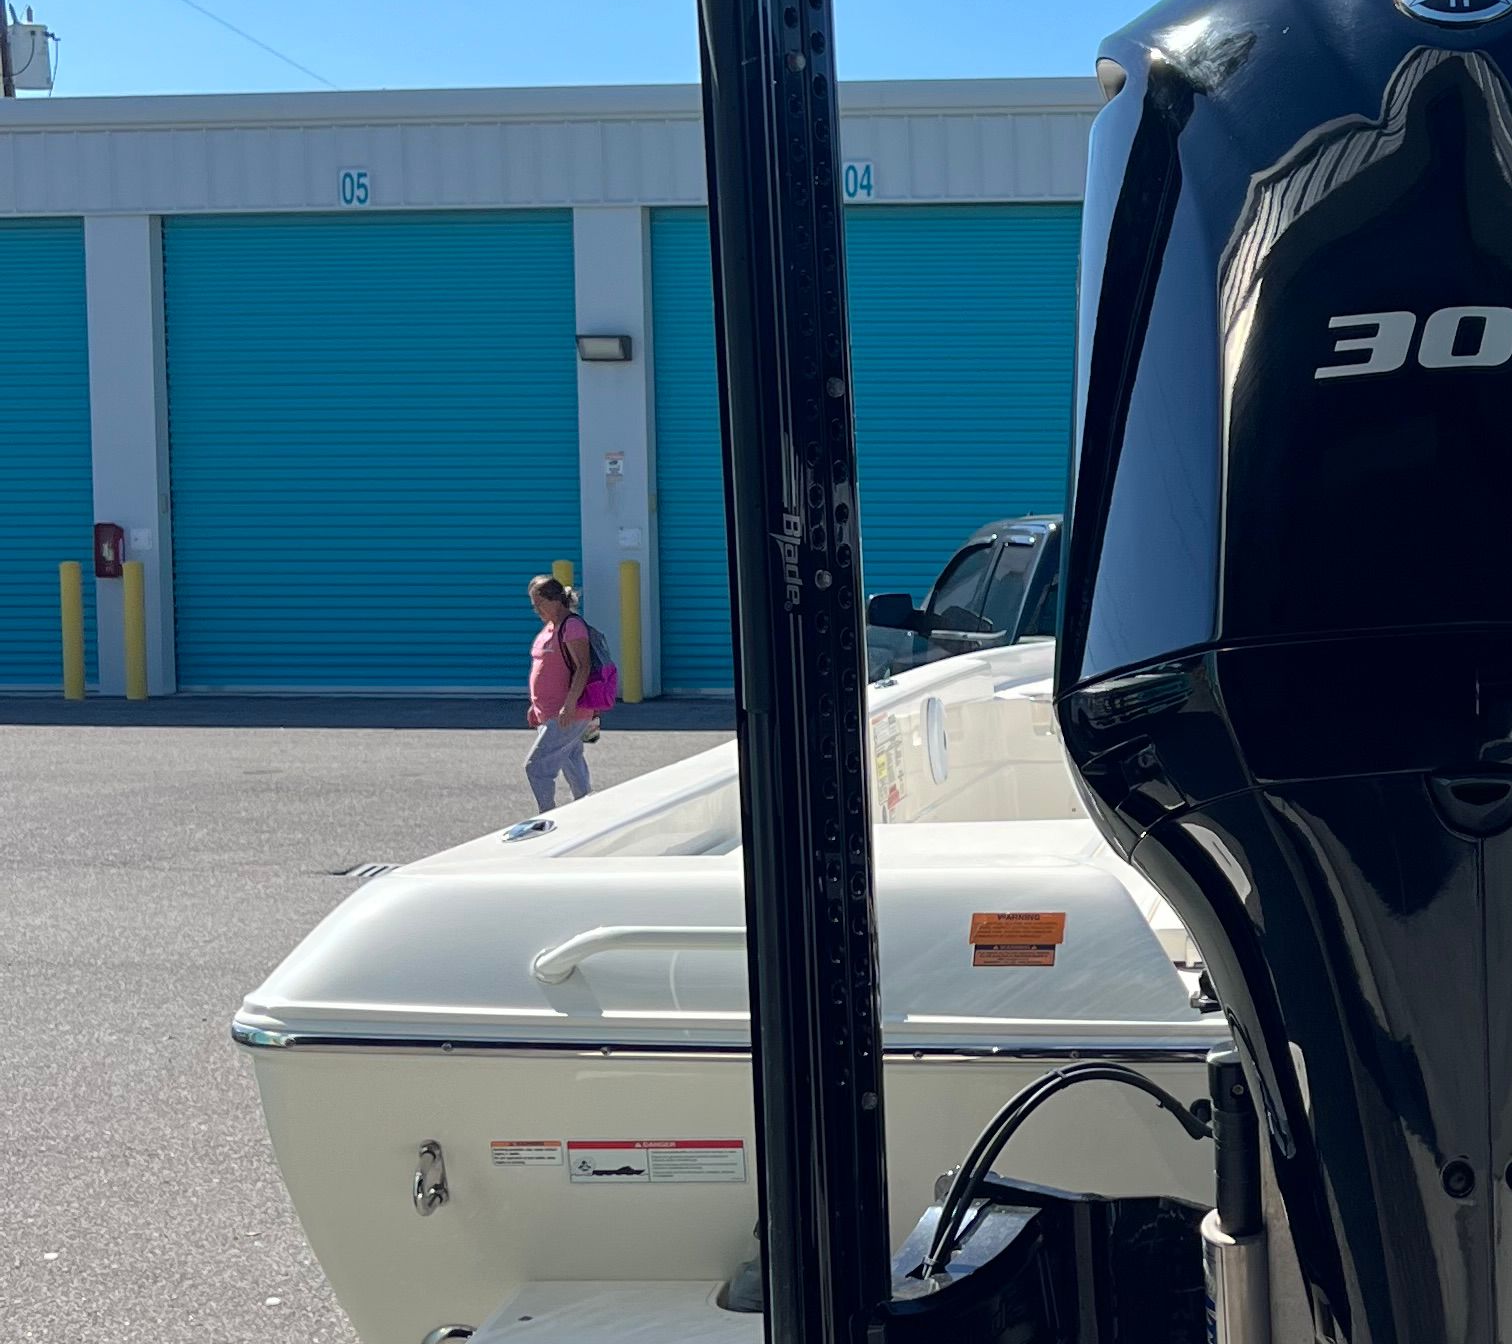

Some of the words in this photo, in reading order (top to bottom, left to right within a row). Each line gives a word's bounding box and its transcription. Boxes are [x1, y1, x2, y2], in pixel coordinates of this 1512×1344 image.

[342, 171, 369, 205] 05
[845, 164, 873, 198] 04
[768, 512, 804, 606] Blade
